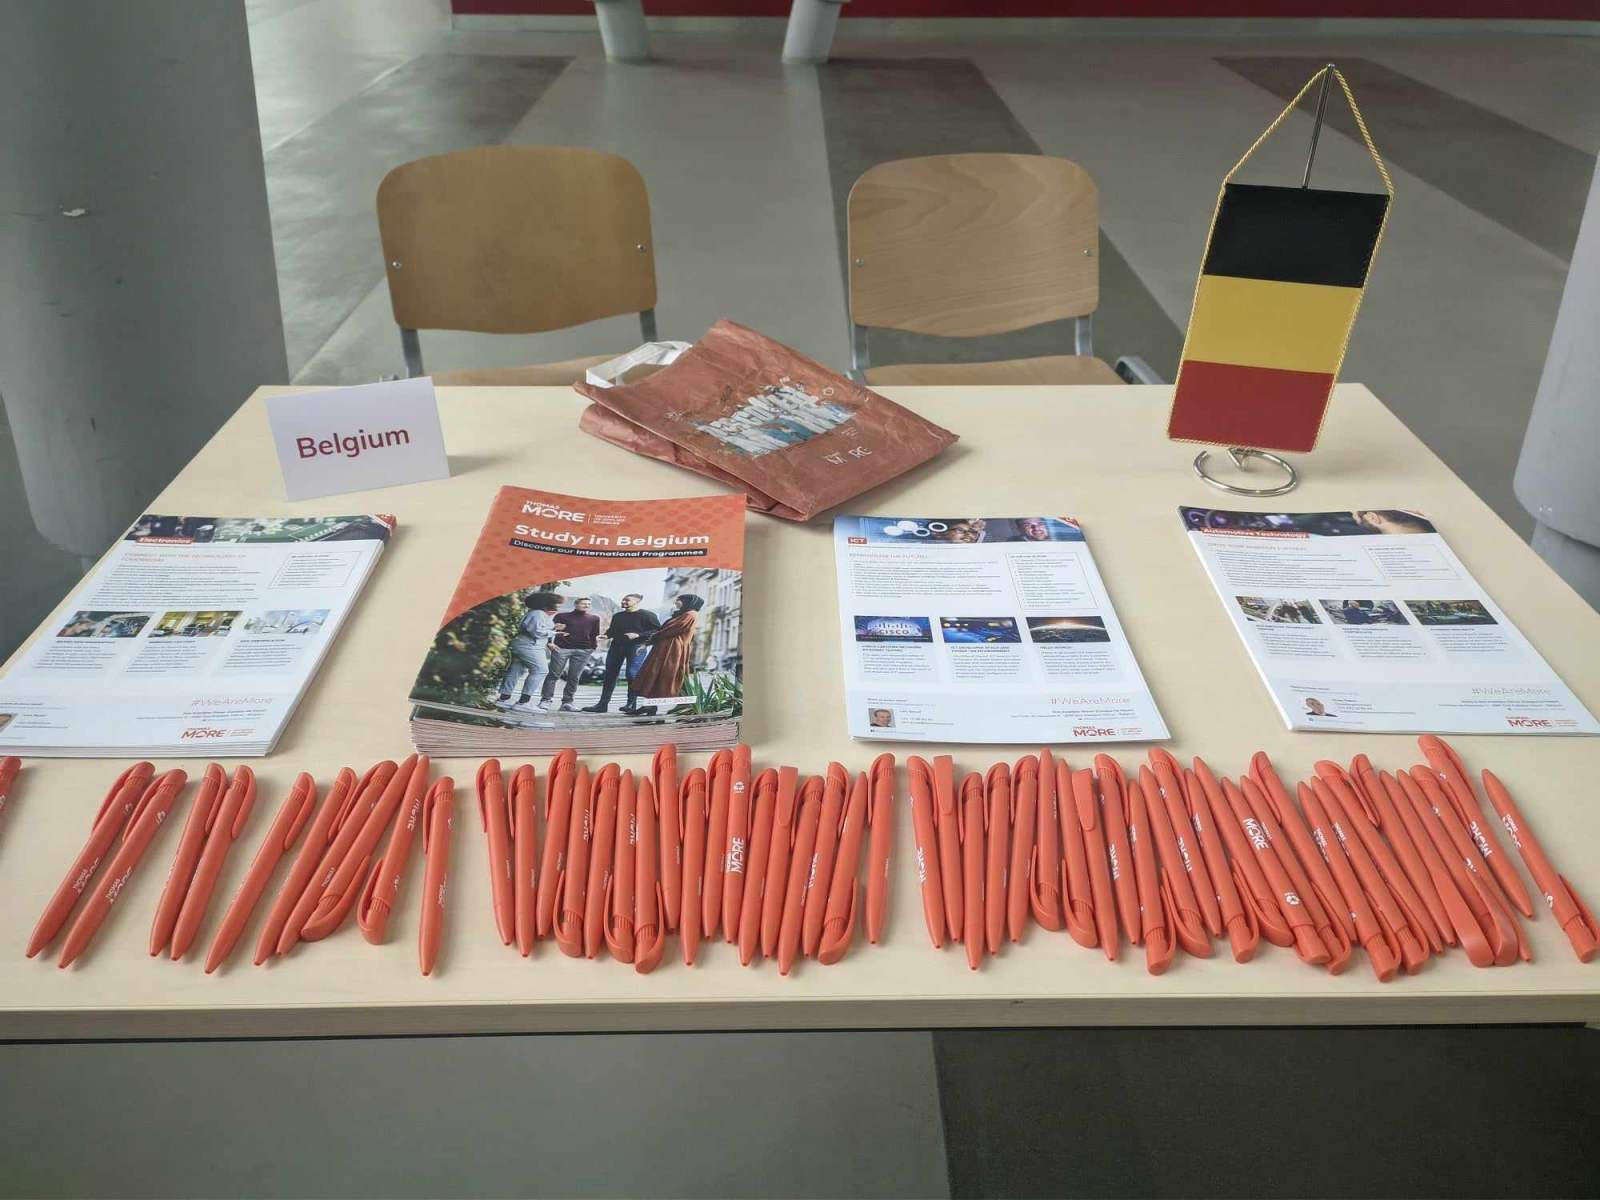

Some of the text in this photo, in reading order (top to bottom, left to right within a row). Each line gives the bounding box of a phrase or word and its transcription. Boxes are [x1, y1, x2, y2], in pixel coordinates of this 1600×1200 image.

[296, 429, 410, 459] Belgium
[522, 504, 586, 522] MORE
[514, 524, 710, 548] Study in Belgium
[513, 540, 555, 552] Discover
[576, 549, 640, 557] International
[1072, 728, 1117, 737] MORE
[1506, 719, 1553, 728] MORE
[181, 729, 227, 739] MORE
[1243, 817, 1269, 850] MORE
[731, 836, 745, 874] MORE
